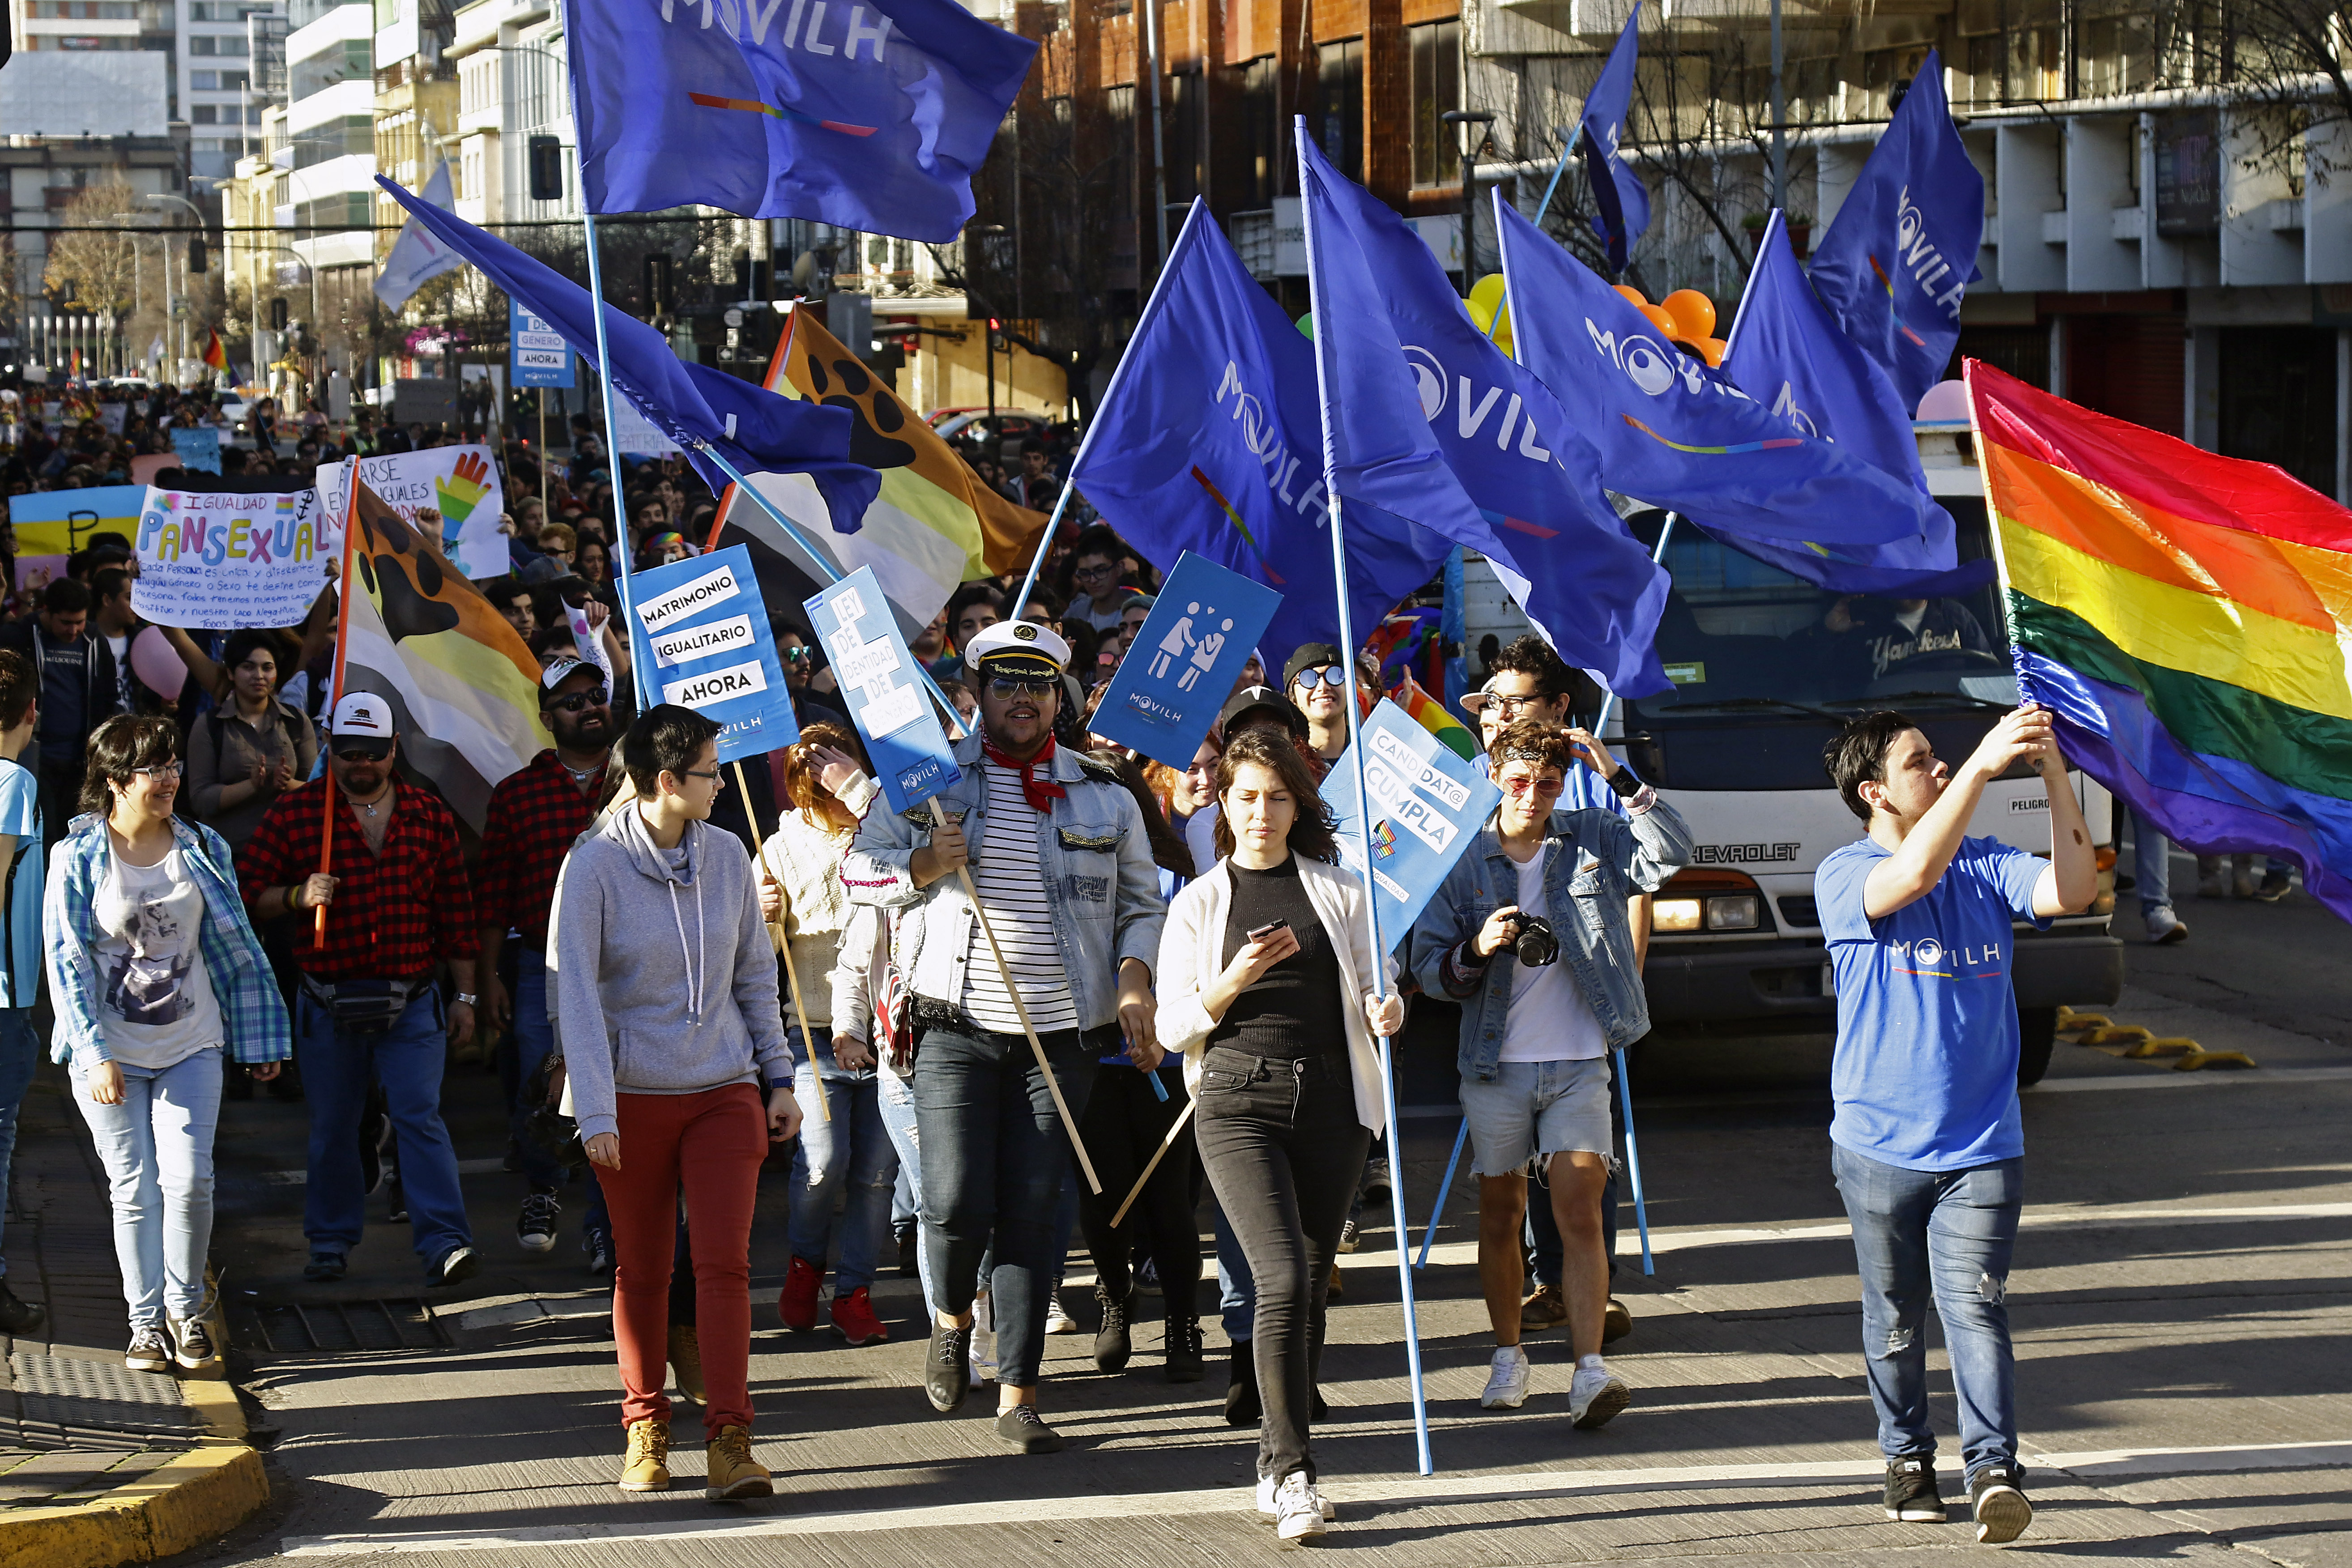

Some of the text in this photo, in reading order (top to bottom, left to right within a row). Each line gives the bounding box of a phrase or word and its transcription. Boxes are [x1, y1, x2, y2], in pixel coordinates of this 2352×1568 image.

[533, 319, 547, 330] DE
[524, 354, 558, 364] AHORA
[1400, 344, 1565, 471] OVIL
[1216, 360, 1331, 528] MOVILH
[338, 458, 401, 488] AARSE
[184, 495, 266, 510] IGUALDAD
[138, 511, 329, 566] PANSEXUAL
[140, 562, 163, 572] Cada
[205, 568, 217, 577] es
[254, 570, 261, 578] y
[246, 581, 259, 591] te
[643, 576, 731, 625] MATRIMONIO
[835, 592, 860, 622] LEY
[658, 625, 746, 658] IGUALITARIO
[836, 627, 857, 654] DE
[46, 656, 83, 666] MELBOURNE
[841, 645, 894, 681] IDENTIDAD
[681, 672, 752, 704] AHORA
[869, 673, 890, 699] DE
[1129, 692, 1182, 722] MOVILH
[715, 717, 761, 740] VILH
[901, 763, 939, 789] MOVILH
[1377, 735, 1464, 805] CANDIDAT@
[1367, 766, 1449, 845] CUMPLA
[2012, 799, 2049, 810] PELIGRO
[1692, 843, 1801, 863] HEVROLET
[1891, 937, 2001, 967] MOILH
